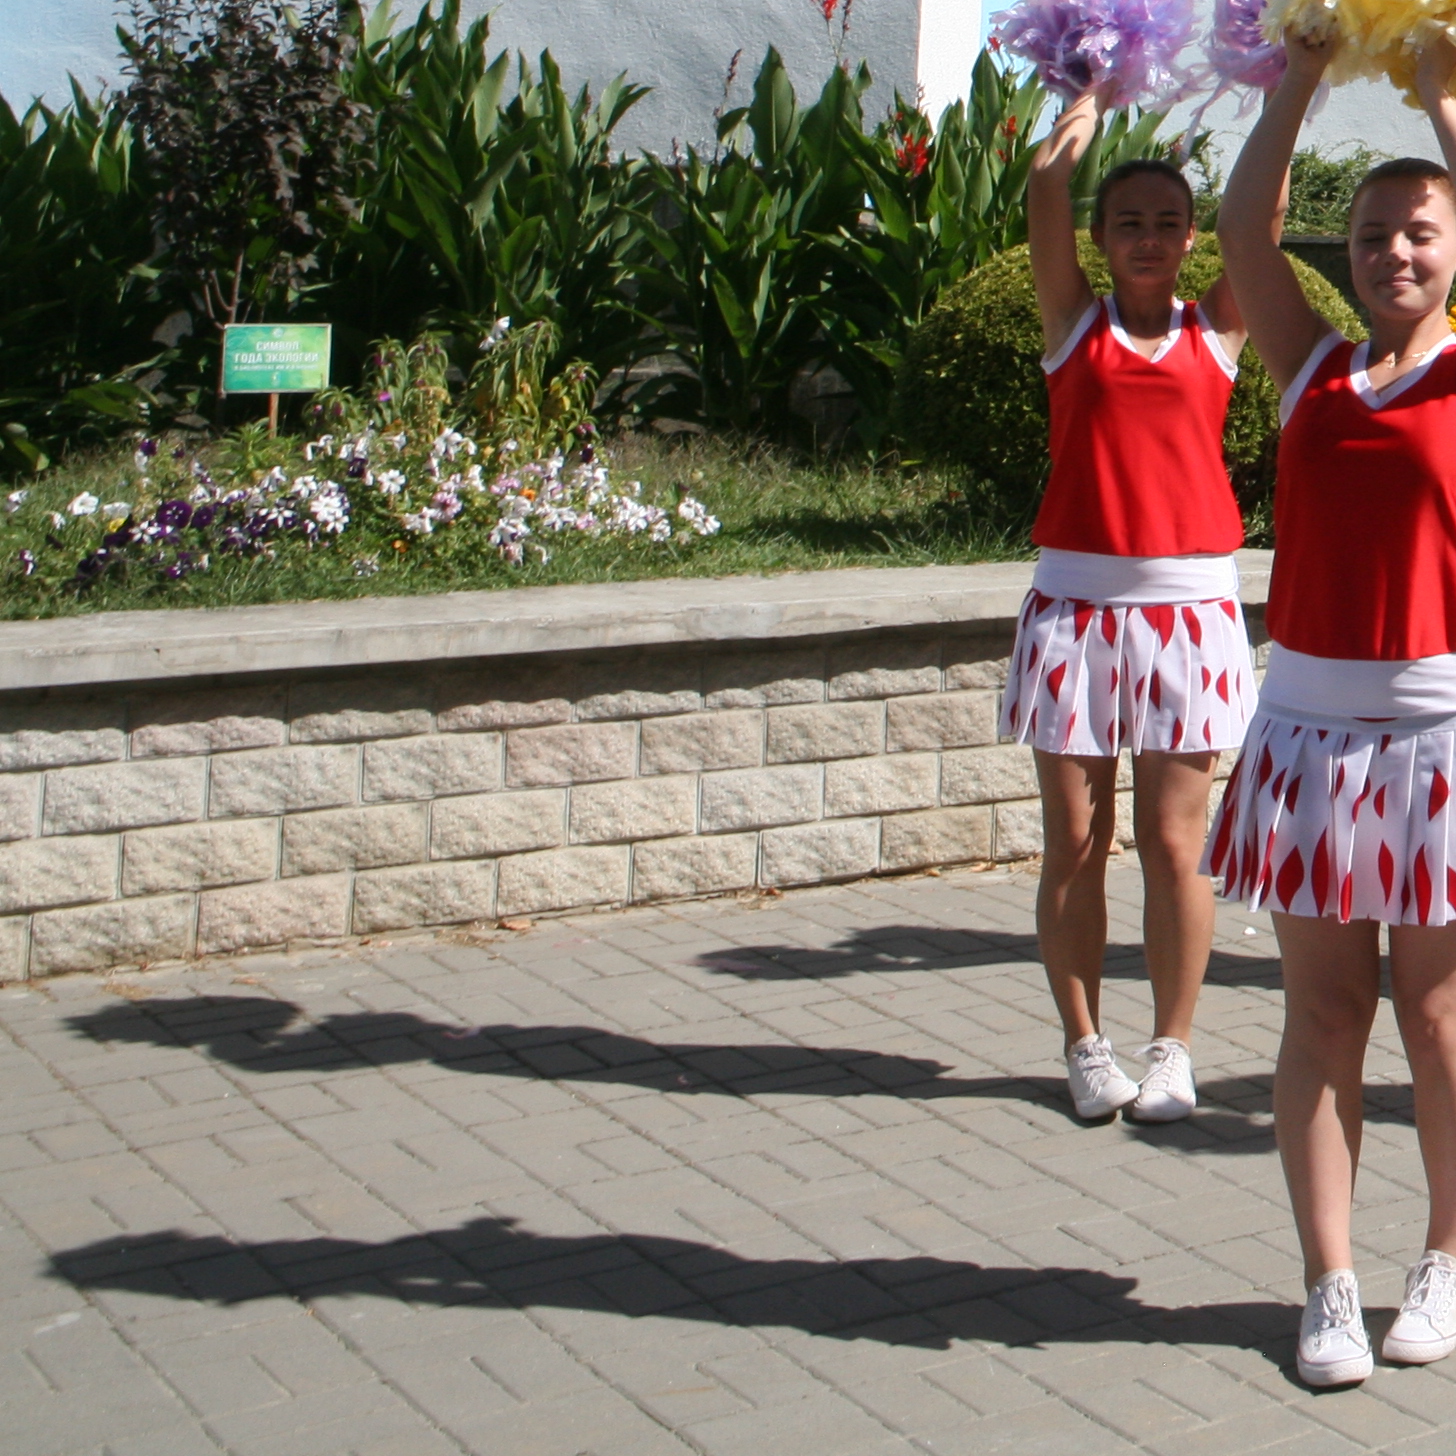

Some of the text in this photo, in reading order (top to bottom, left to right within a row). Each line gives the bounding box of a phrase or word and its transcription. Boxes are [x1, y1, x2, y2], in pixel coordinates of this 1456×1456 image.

[255, 340, 300, 352] СИМВОЛ
[233, 352, 319, 364] ГОДА ЭКОЛОГИИ
